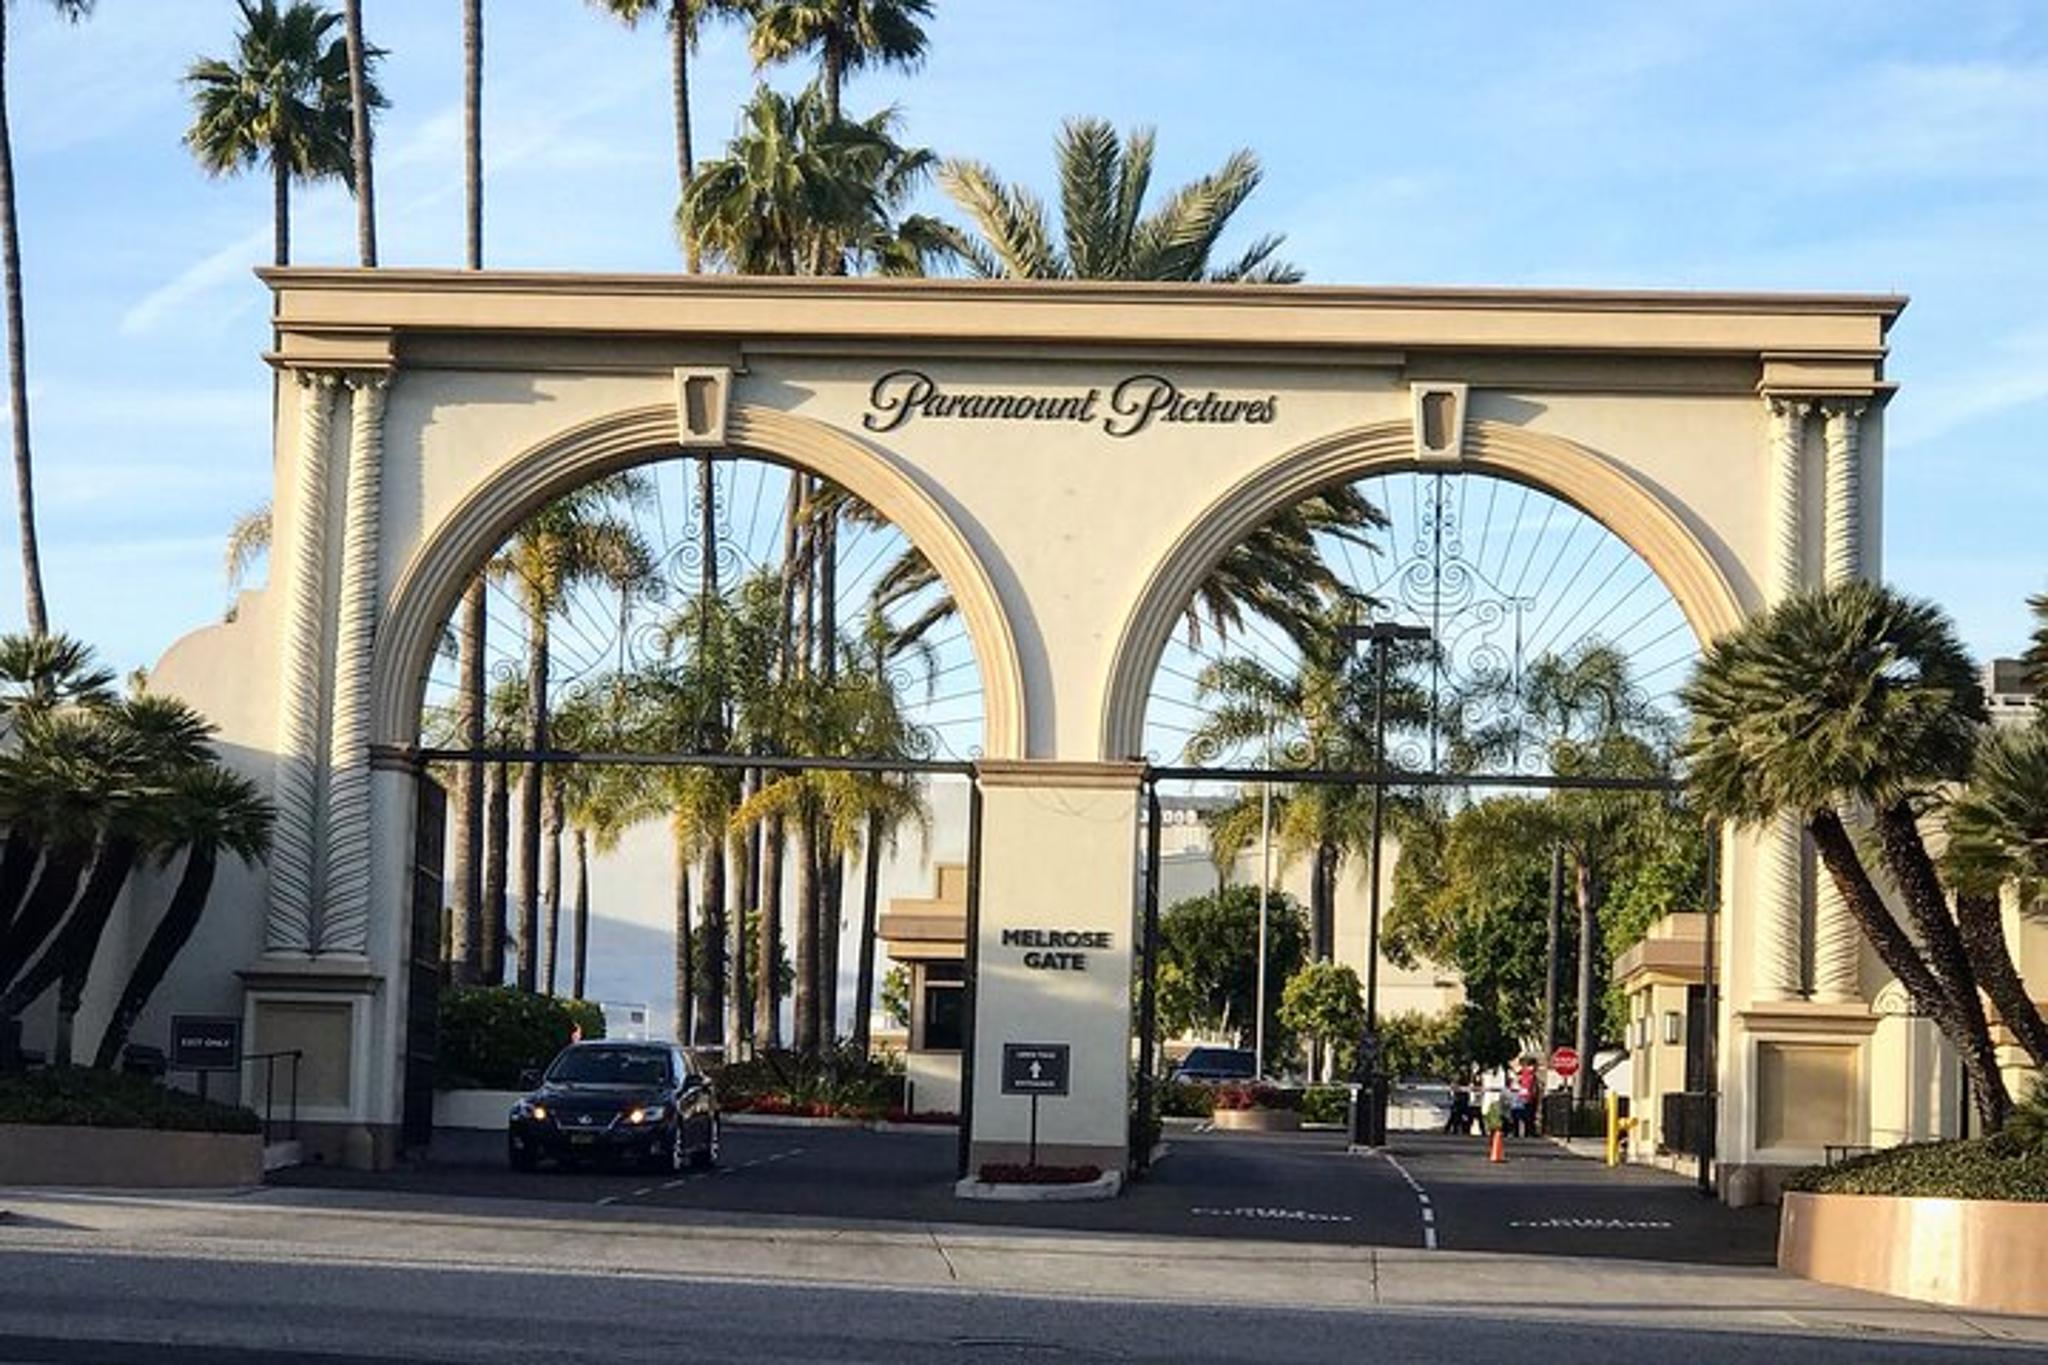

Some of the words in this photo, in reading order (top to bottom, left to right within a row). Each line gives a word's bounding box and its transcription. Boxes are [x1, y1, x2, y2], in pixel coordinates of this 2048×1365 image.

[863, 369, 1098, 433] Paramount
[1102, 374, 1279, 438] Pictures
[1002, 929, 1114, 949] MELROSE
[1023, 952, 1087, 971] GATE
